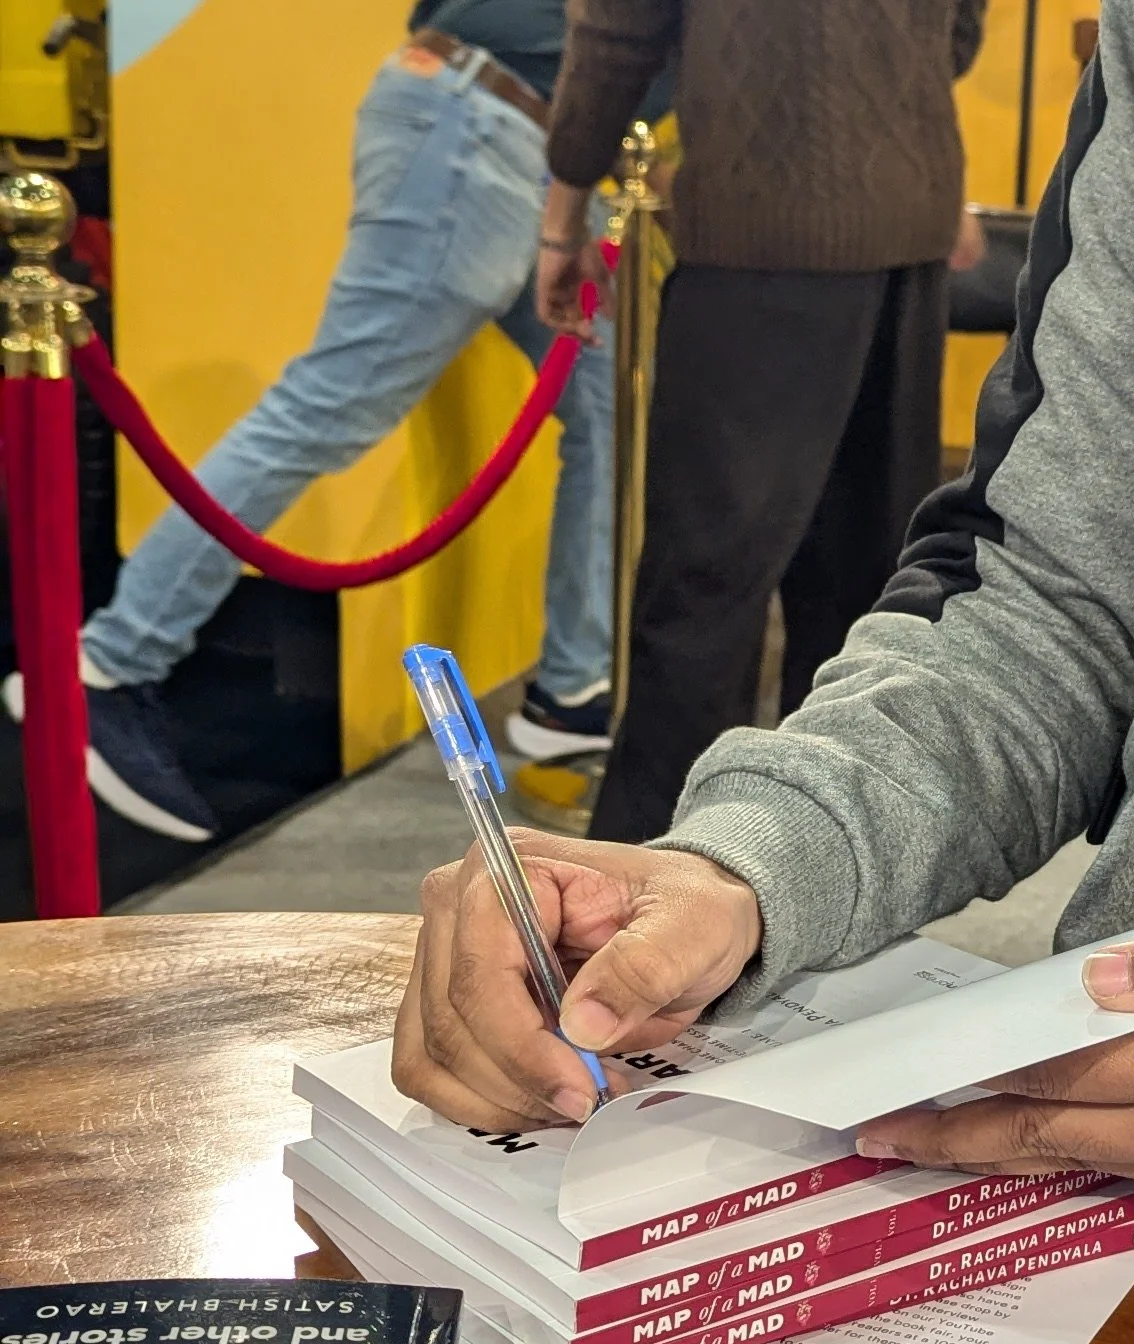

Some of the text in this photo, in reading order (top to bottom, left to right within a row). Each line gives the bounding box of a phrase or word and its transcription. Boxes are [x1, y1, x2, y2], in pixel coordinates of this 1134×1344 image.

[948, 1171, 1056, 1211] Dr. RAGHAVA
[641, 1181, 798, 1245] MAP of a MAD
[932, 1171, 1111, 1239] Dr. RAGHAVA PENDYAL
[929, 1207, 1125, 1281] Dr. RAGHAVA PENDYALA
[1014, 1241, 1102, 1274] PENDYALA
[640, 1241, 805, 1306] MAP of a MAD
[977, 1296, 1008, 1308] have
[985, 1287, 1022, 1301] home
[36, 1298, 354, 1318] SATISH BHALERAO
[633, 1274, 793, 1343] MAP of a MAD
[919, 1304, 980, 1323] interview
[961, 1301, 991, 1315] drop
[994, 1310, 1011, 1320] by
[851, 1320, 901, 1337] readers
[904, 1333, 919, 1341] at
[870, 1314, 891, 1324] the
[894, 1320, 926, 1332] book
[912, 1314, 934, 1323] our
[938, 1317, 995, 1337] YouTube
[780, 1336, 793, 1344] to
[844, 1329, 866, 1339] for
